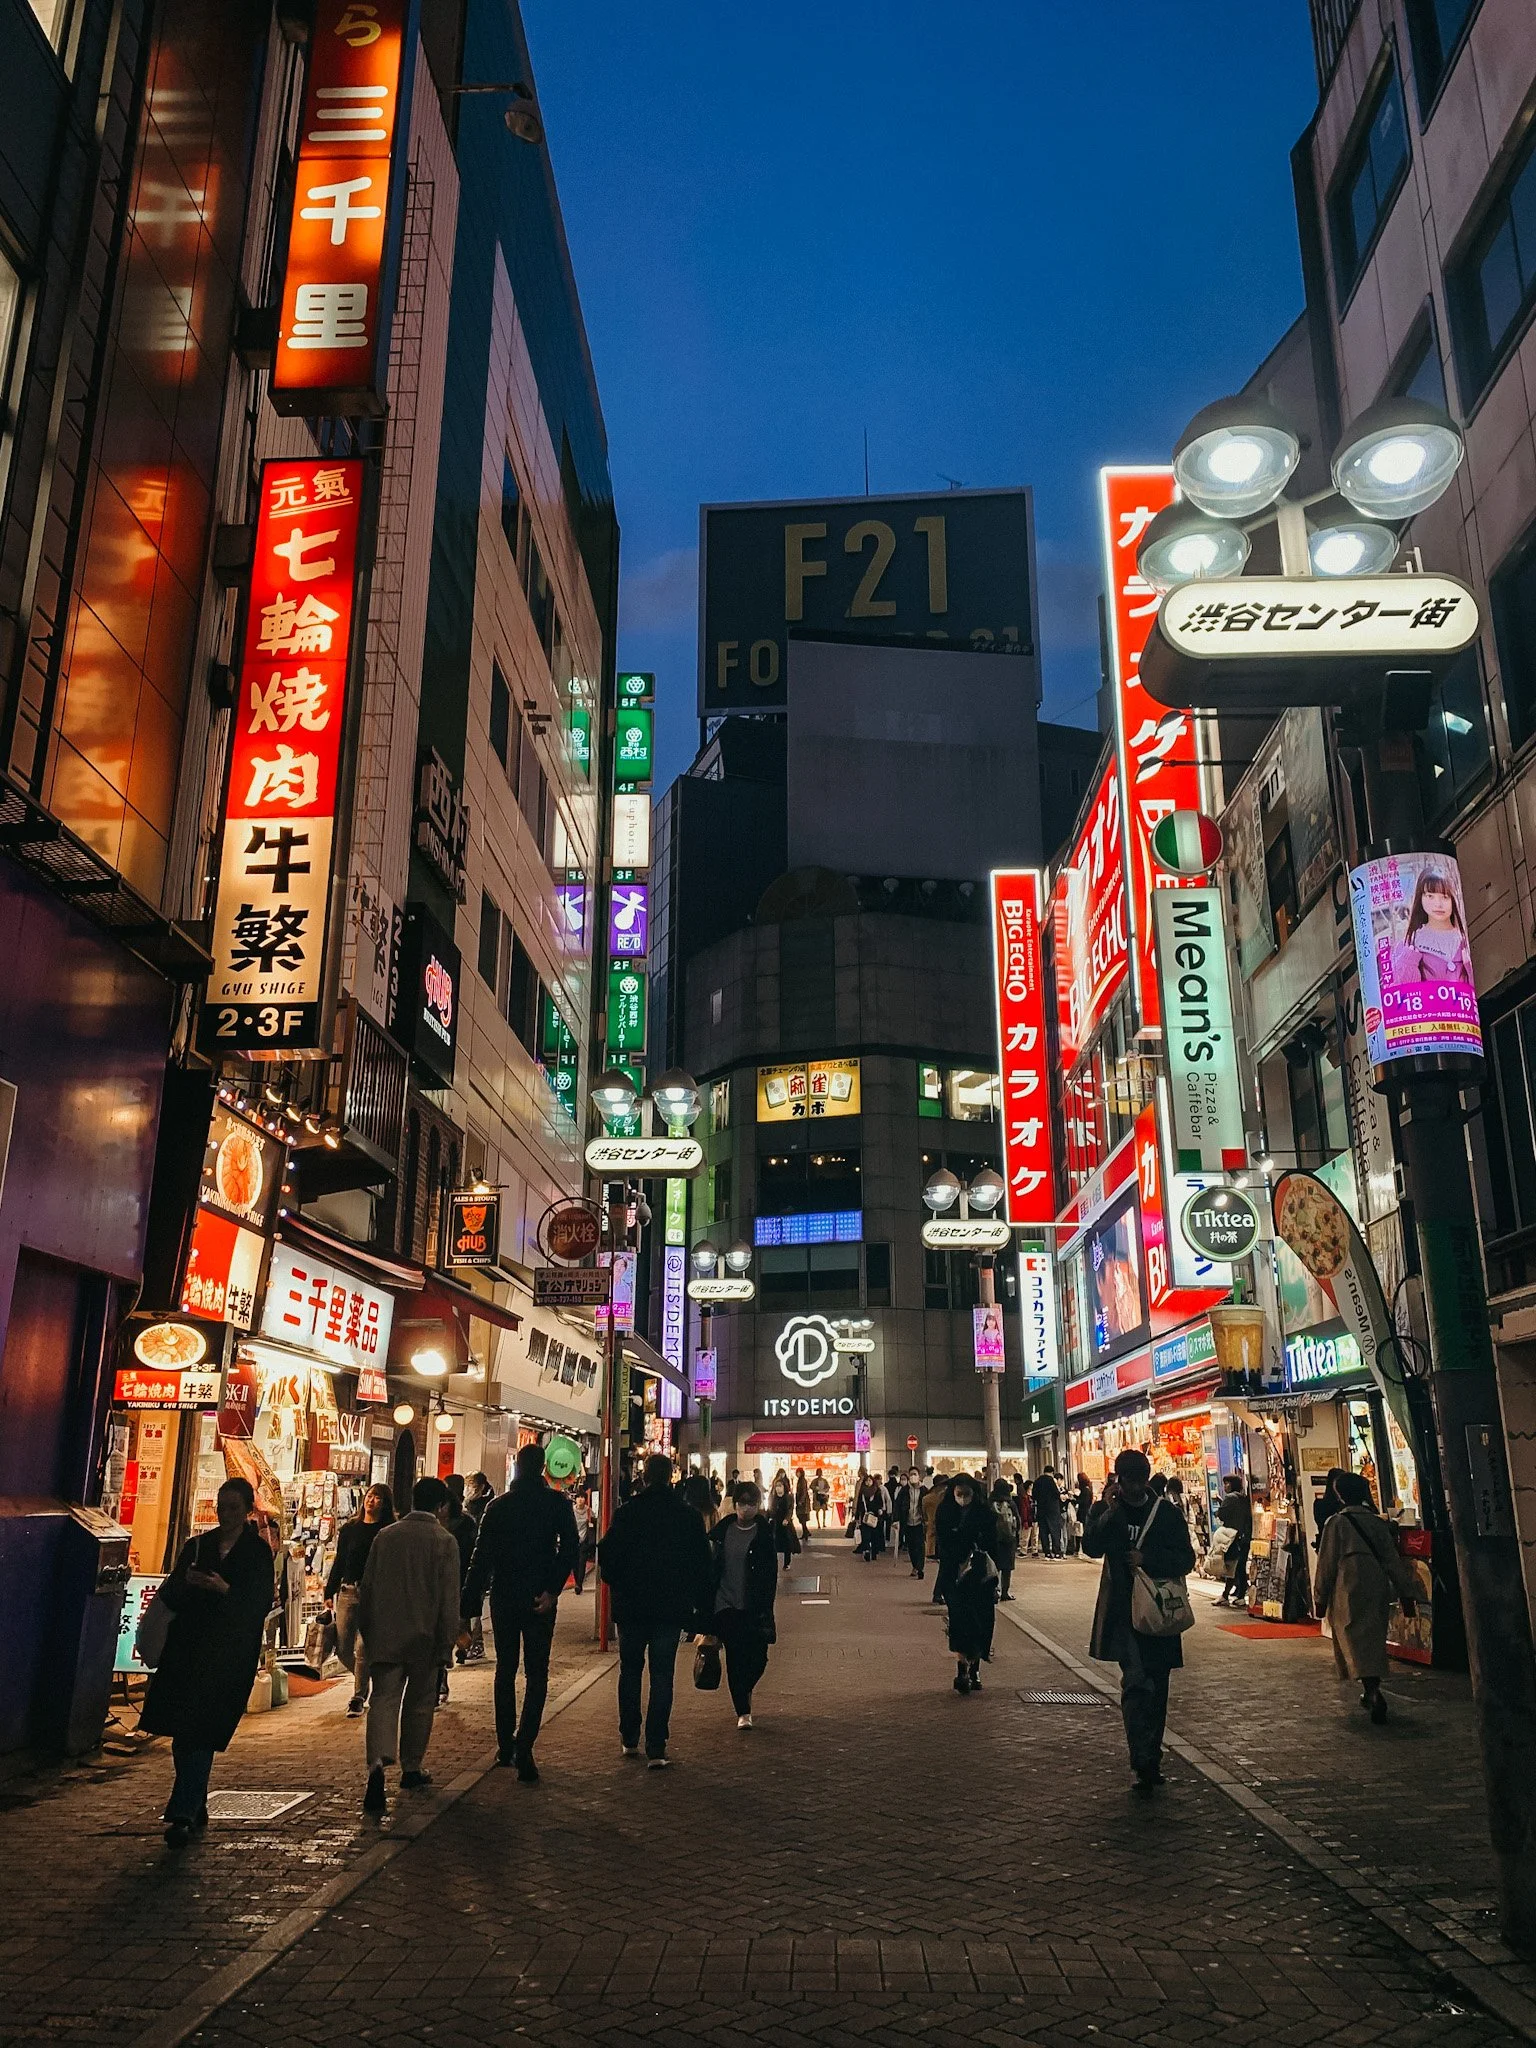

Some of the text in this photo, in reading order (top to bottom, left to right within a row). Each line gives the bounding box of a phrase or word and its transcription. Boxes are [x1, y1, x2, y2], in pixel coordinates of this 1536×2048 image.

[783, 514, 949, 622] F21
[1178, 597, 1461, 634] 渋谷センター街
[244, 527, 341, 809] 七輪焼肉
[621, 698, 637, 707] 5F
[618, 783, 635, 792] 4F
[616, 870, 633, 879] 3F
[227, 826, 311, 974] 牛繁
[1001, 899, 1028, 1003] BIG ECHO
[613, 960, 630, 970] 2F
[1027, 938, 1035, 992] Entertainment
[221, 981, 307, 996] GYU SHIGE
[1172, 900, 1222, 1064] Mean's
[629, 994, 639, 1028] 渋谷西村
[618, 994, 626, 1049] フルーツパーラー
[1392, 1024, 1423, 1037] FREE!
[611, 1054, 627, 1064] 1F
[789, 1073, 828, 1097] 麻雀
[792, 1100, 826, 1117] カボ
[1005, 1022, 1048, 1197] カラオケ
[590, 1147, 697, 1161] 渋谷センター街
[453, 1195, 469, 1203] ALES
[474, 1194, 498, 1203] STOUTS
[1190, 1207, 1255, 1228] Tiktea
[552, 1222, 596, 1244] 消火栓
[926, 1227, 1005, 1238] 渋谷センター街
[456, 1235, 487, 1253] HUB
[452, 1257, 468, 1265] FISH
[472, 1256, 492, 1265] CHIPS
[691, 1284, 752, 1294] 渋谷センター街
[227, 1283, 253, 1324] 牛繁
[282, 1266, 380, 1354] 三千里薬品
[1031, 1276, 1048, 1372] ココカラファイン
[1285, 1335, 1338, 1383] Tiktea
[120, 1382, 177, 1399] 七輪焼肉
[183, 1382, 214, 1400] 牛繁
[126, 1400, 161, 1409] YAKINIKU
[763, 1397, 854, 1417] ITS'DEMO
